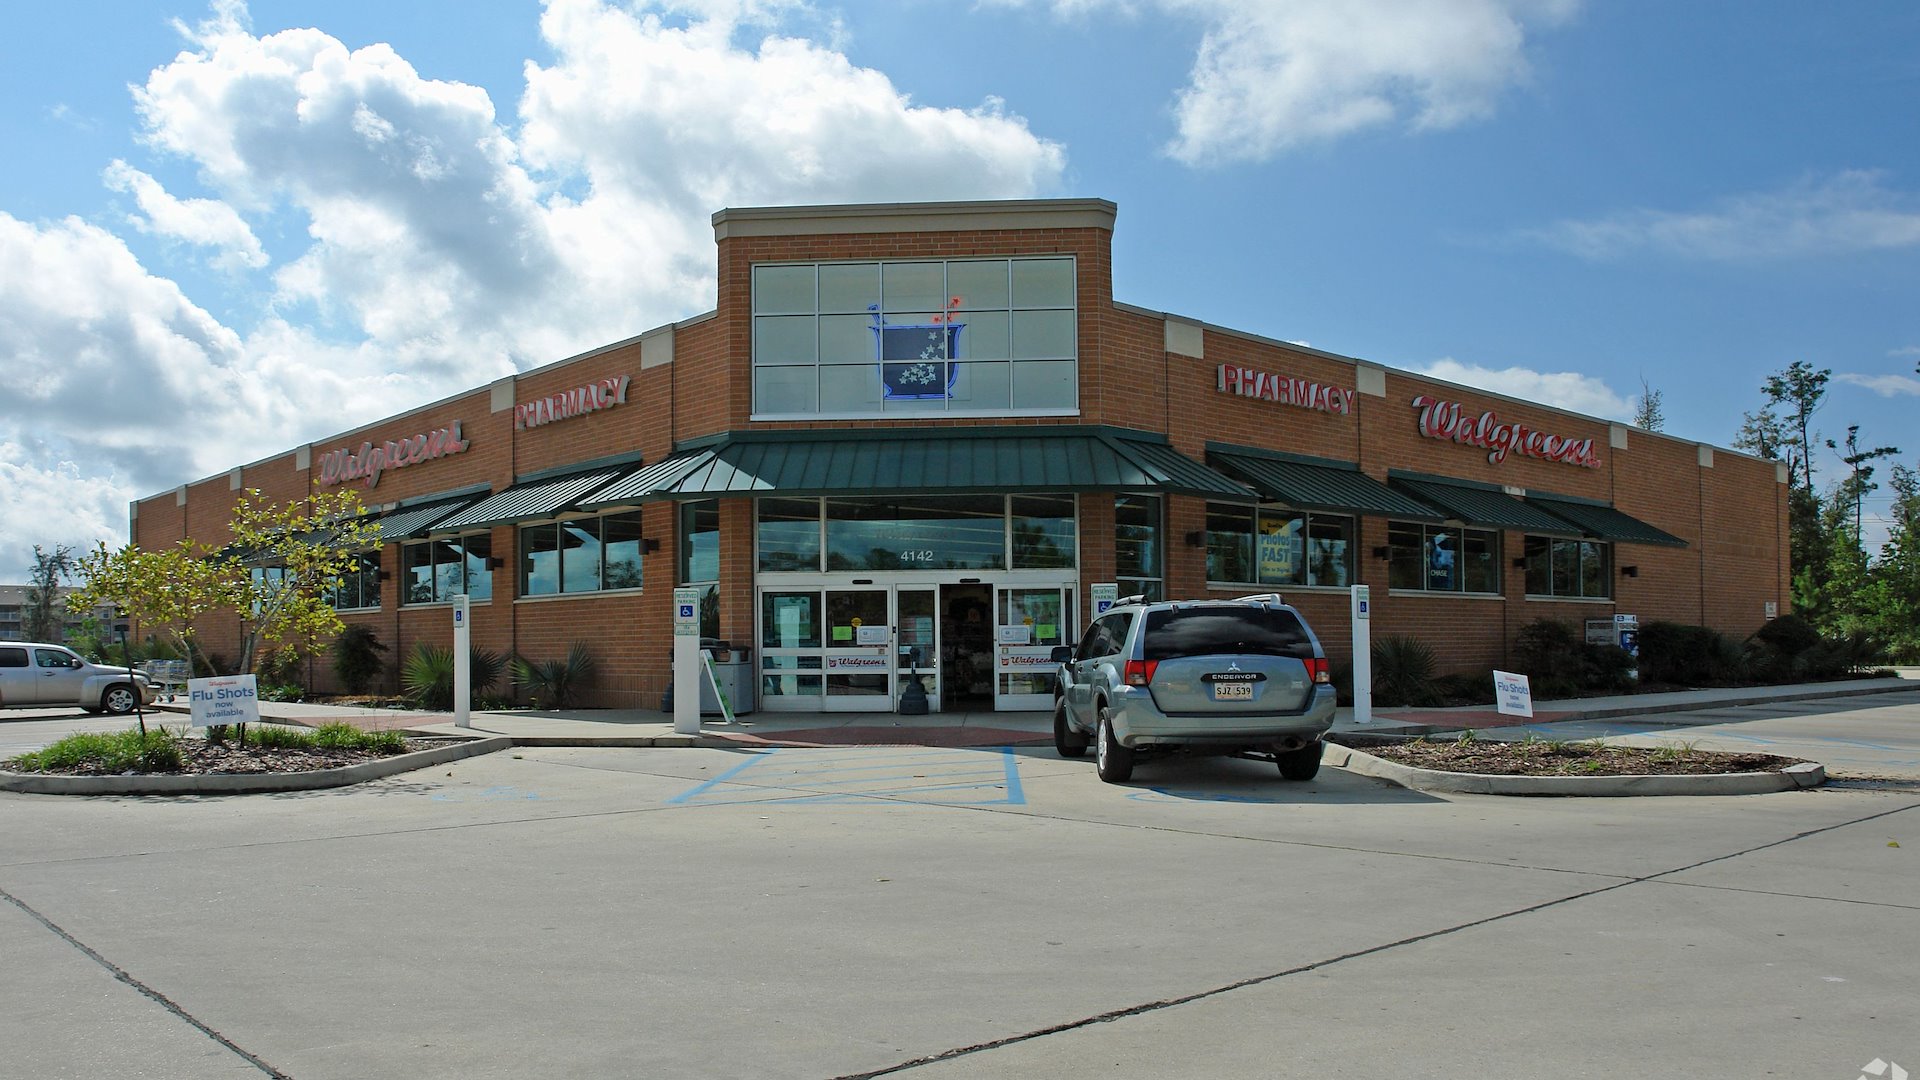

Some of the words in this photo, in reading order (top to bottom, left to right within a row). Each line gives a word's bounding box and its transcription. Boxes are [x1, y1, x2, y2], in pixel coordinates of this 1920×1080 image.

[1217, 364, 1355, 416] PHARMACY
[514, 375, 631, 431] PHARMACY
[1412, 395, 1600, 468] Walgreens
[318, 419, 470, 489] Walgreens
[1261, 533, 1290, 546] Photos
[901, 550, 933, 561] 4142
[1262, 547, 1290, 562] FAST
[838, 658, 886, 667] Walgreens
[1011, 656, 1054, 666] Walgreen
[192, 690, 213, 701] Flu
[217, 688, 255, 699] Shots
[1216, 687, 1231, 695] SJZ
[1236, 687, 1251, 695] 539
[1497, 682, 1509, 692] Flu
[1510, 684, 1528, 694] Shots
[206, 709, 244, 718] available
